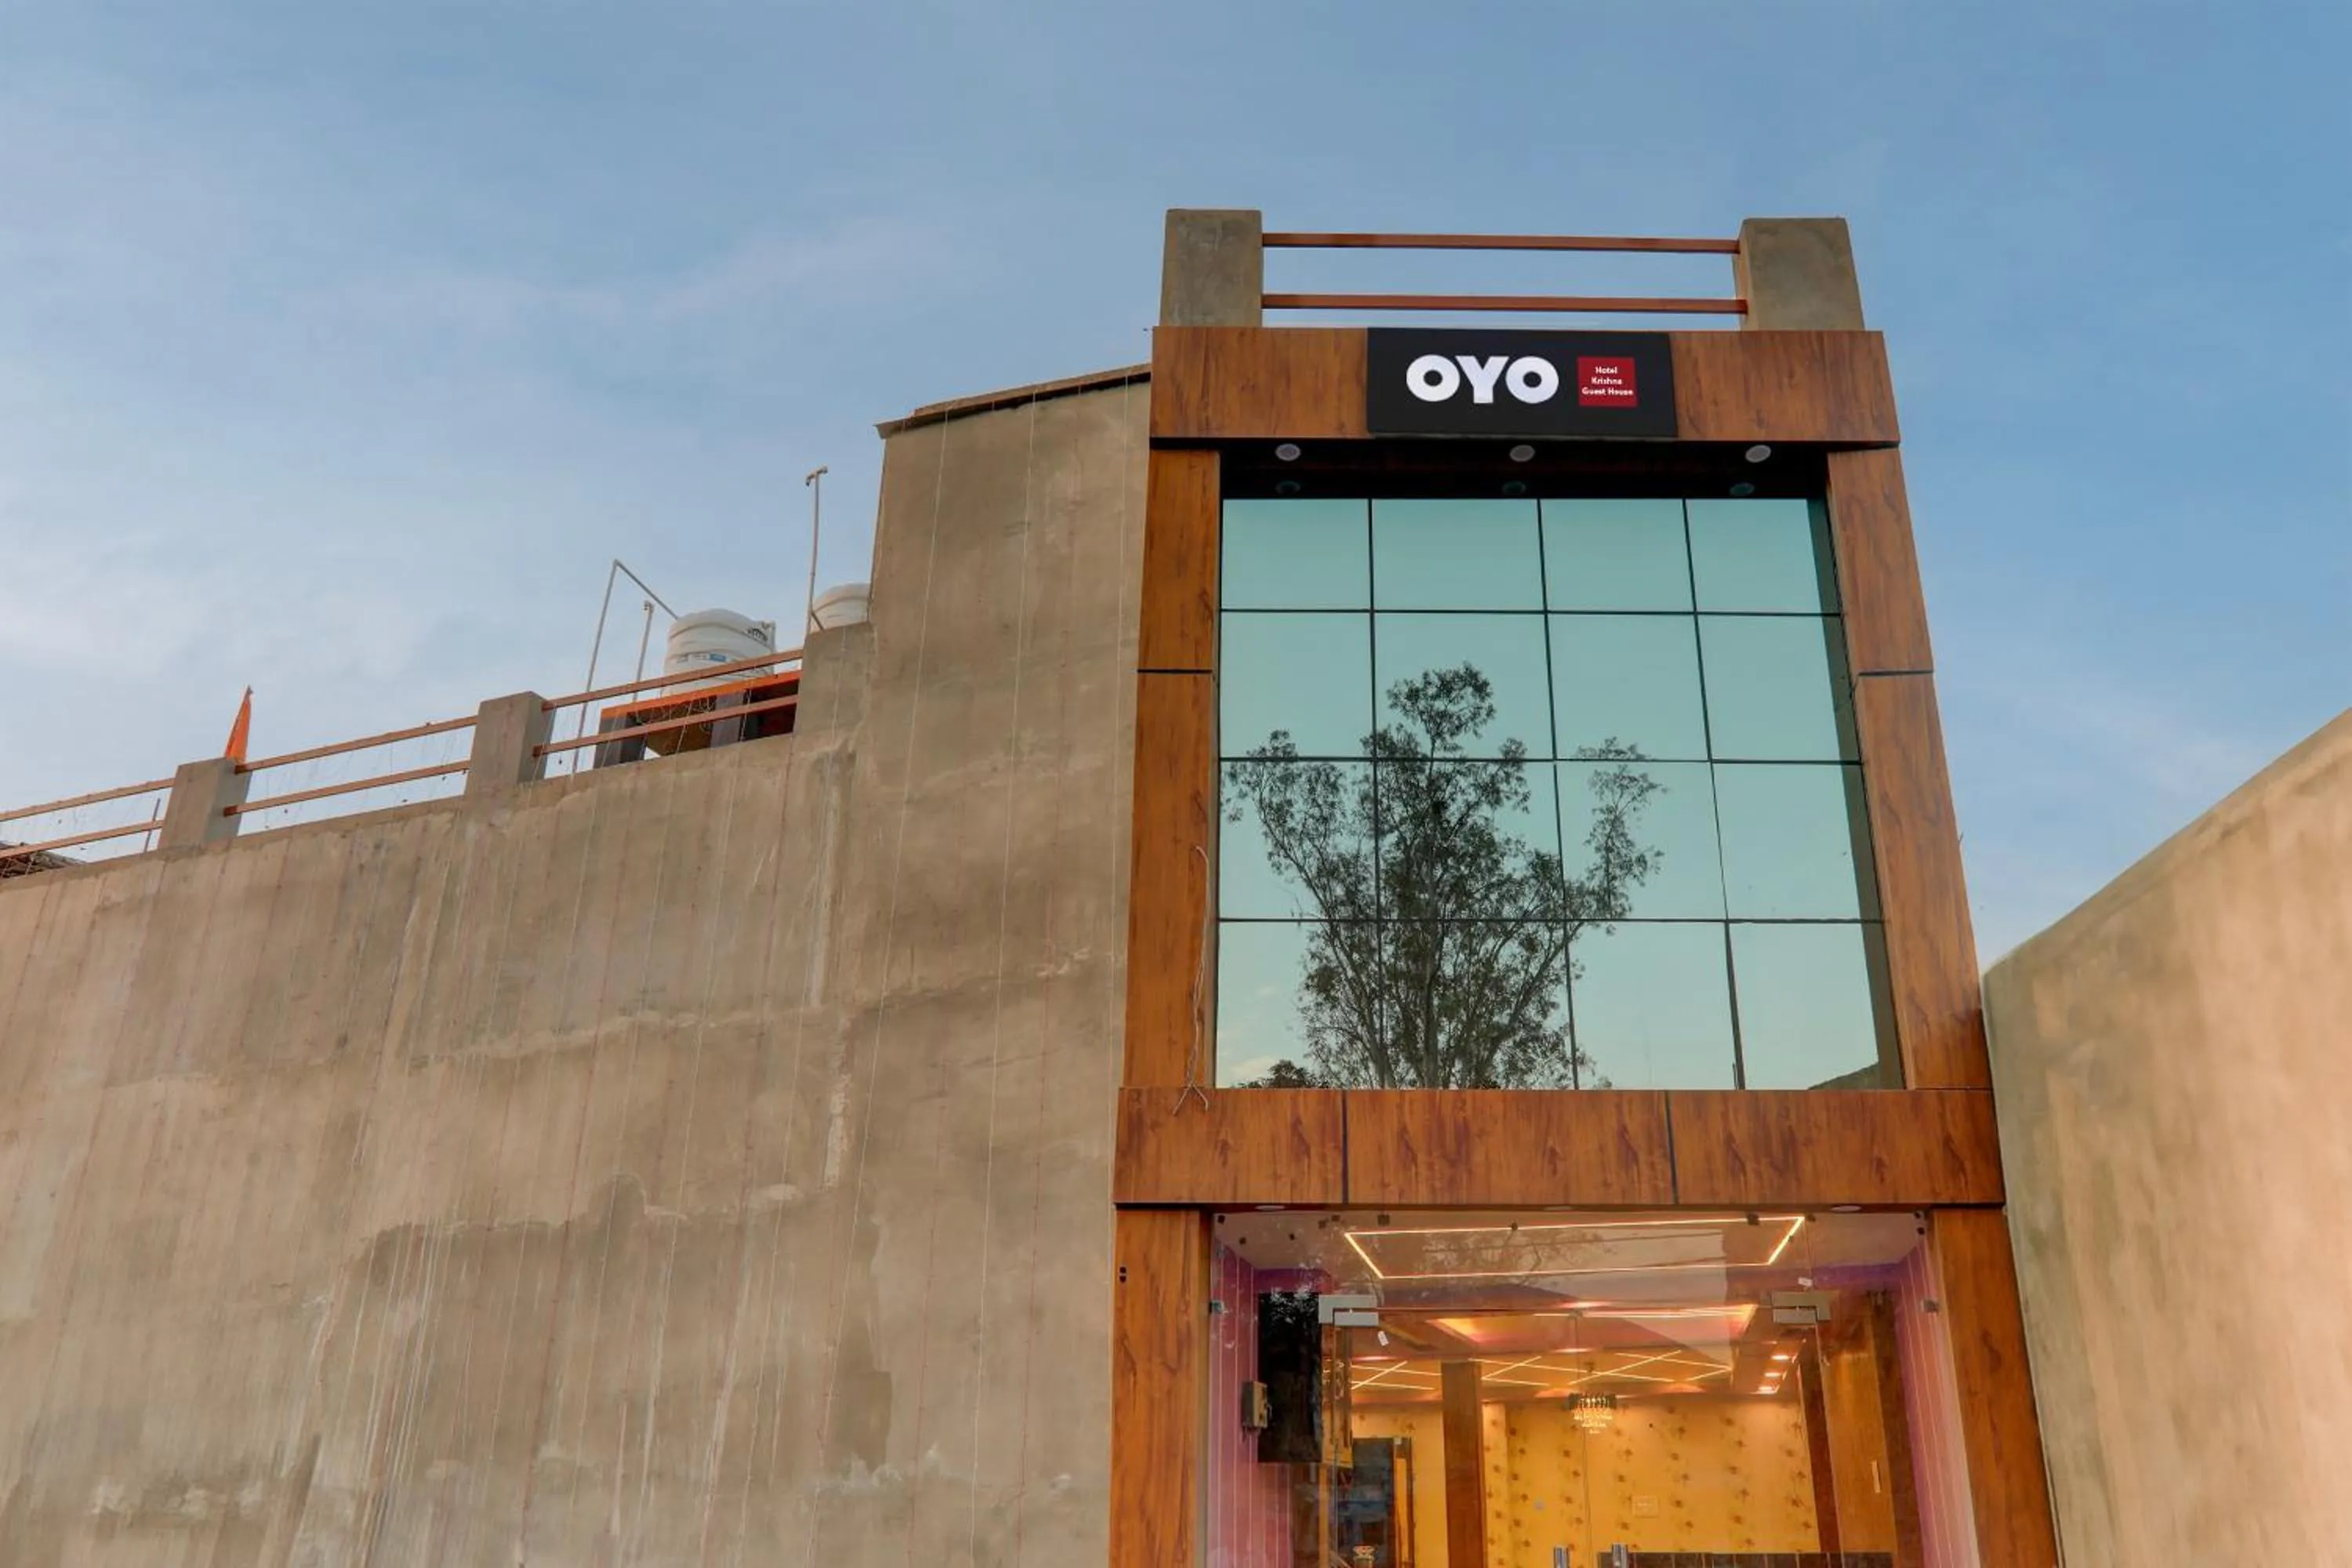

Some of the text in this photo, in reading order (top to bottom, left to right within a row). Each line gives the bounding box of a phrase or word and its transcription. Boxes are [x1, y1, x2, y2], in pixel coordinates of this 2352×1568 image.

[1406, 354, 1559, 404] OYO
[1591, 376, 1622, 385] Krishna
[1581, 387, 1634, 396] Guest House
